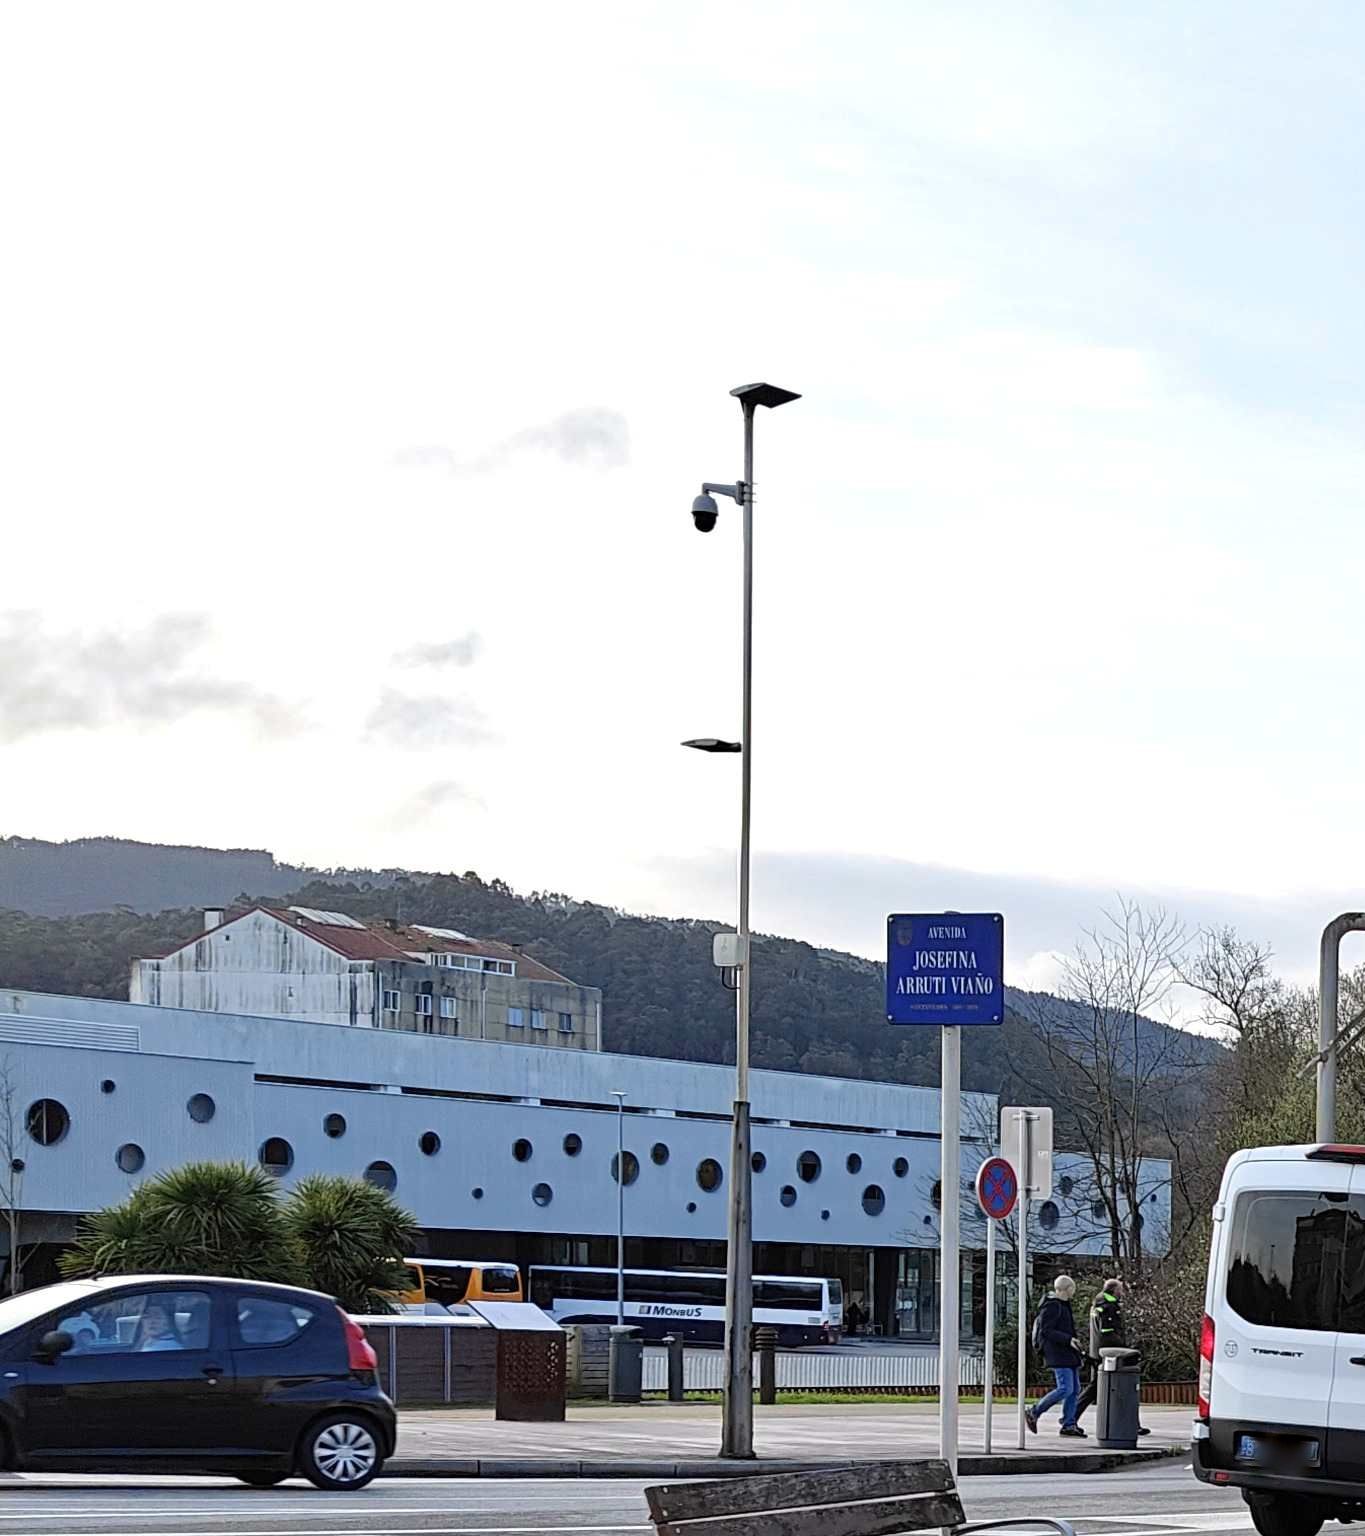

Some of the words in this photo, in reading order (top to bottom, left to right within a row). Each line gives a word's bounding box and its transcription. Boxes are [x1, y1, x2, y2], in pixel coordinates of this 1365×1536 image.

[928, 927, 966, 939] AVENIDA
[913, 950, 977, 970] JOSEFINA
[896, 976, 946, 994] ARRUTI
[951, 973, 993, 994] VIAÑO
[1250, 1347, 1304, 1357] TRANSIT
